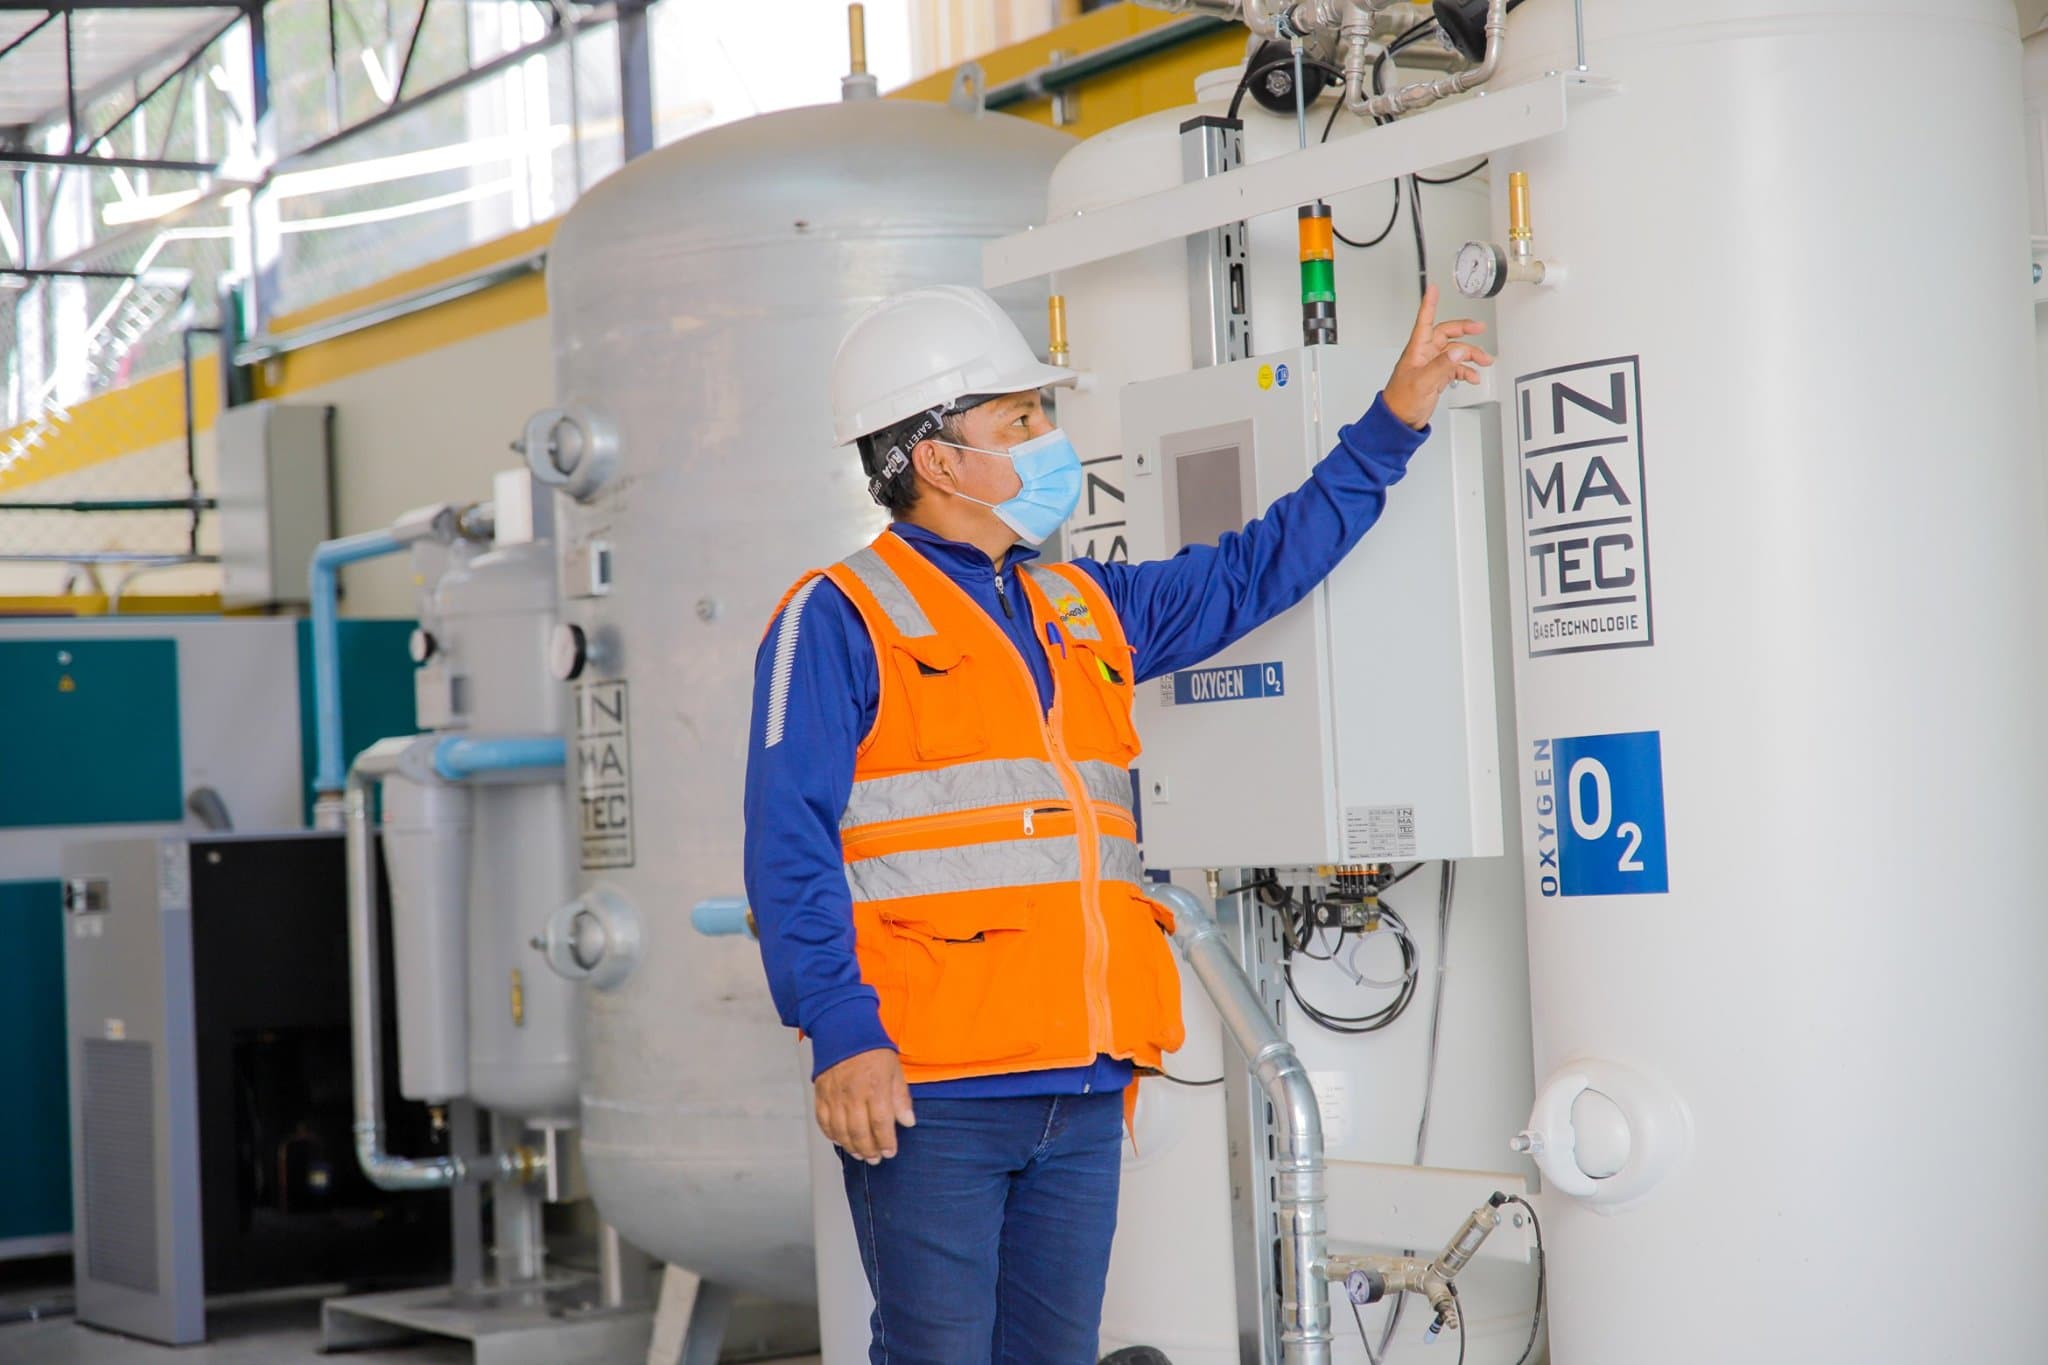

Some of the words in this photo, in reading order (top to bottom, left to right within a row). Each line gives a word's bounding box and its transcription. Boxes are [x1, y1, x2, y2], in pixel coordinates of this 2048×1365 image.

[1522, 371, 1627, 441] IN
[904, 420, 932, 452] SAFETY
[1087, 471, 1125, 516] N
[1525, 455, 1632, 520] MA
[1530, 533, 1635, 597] TEC
[1191, 669, 1244, 700] OXYGEN
[576, 689, 623, 730] IN
[577, 743, 625, 781] MA
[580, 795, 627, 831] TEC
[1533, 738, 1559, 898] OXYGEN
